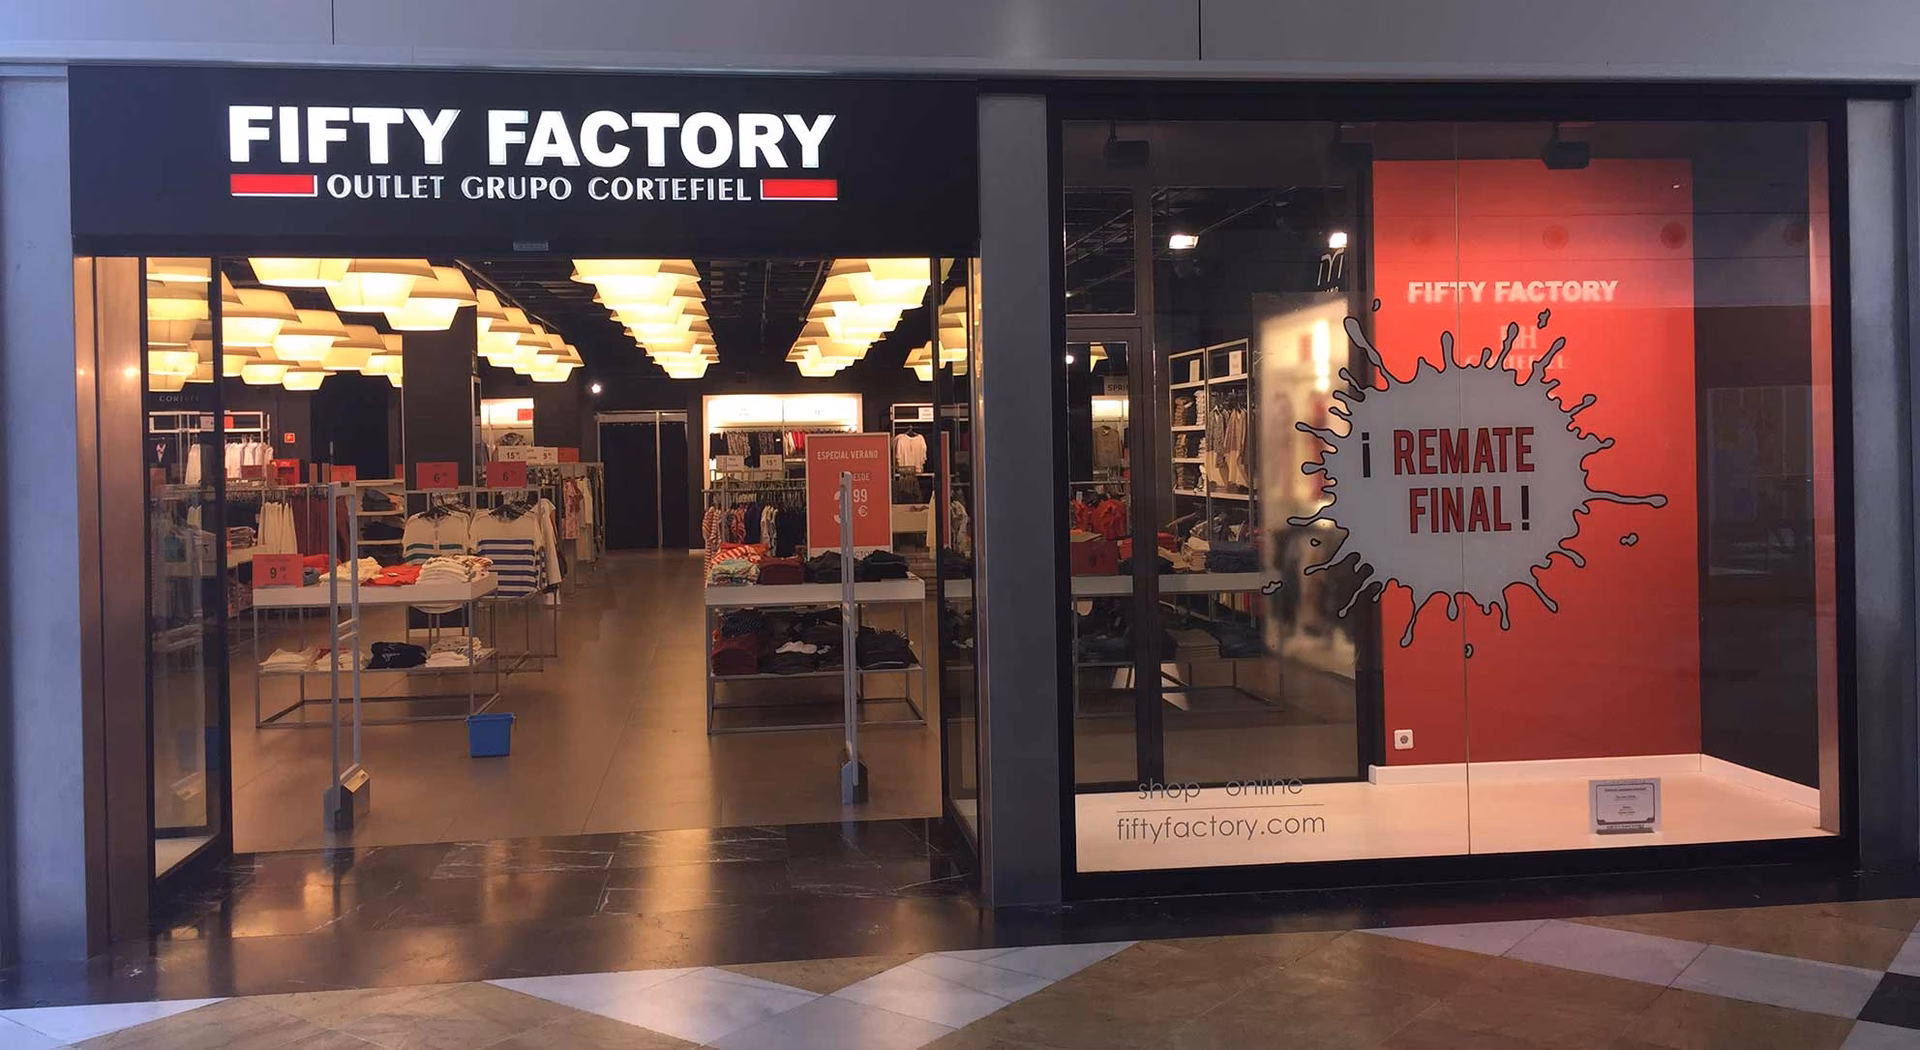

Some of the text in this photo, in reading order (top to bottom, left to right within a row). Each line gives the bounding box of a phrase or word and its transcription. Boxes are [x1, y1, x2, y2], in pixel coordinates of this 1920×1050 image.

[228, 105, 837, 169] FIFTY FACTORY
[326, 173, 752, 201] OUTLET GRUPO CORTEFIEL
[1407, 279, 1619, 304] FIFTY FACTORY
[817, 449, 879, 460] ESPECIAL VERANO
[1393, 426, 1536, 476] REMATE
[852, 472, 871, 482] ESDE
[1137, 774, 1304, 803] shop online
[1116, 815, 1325, 844] fiftyfactory.com
